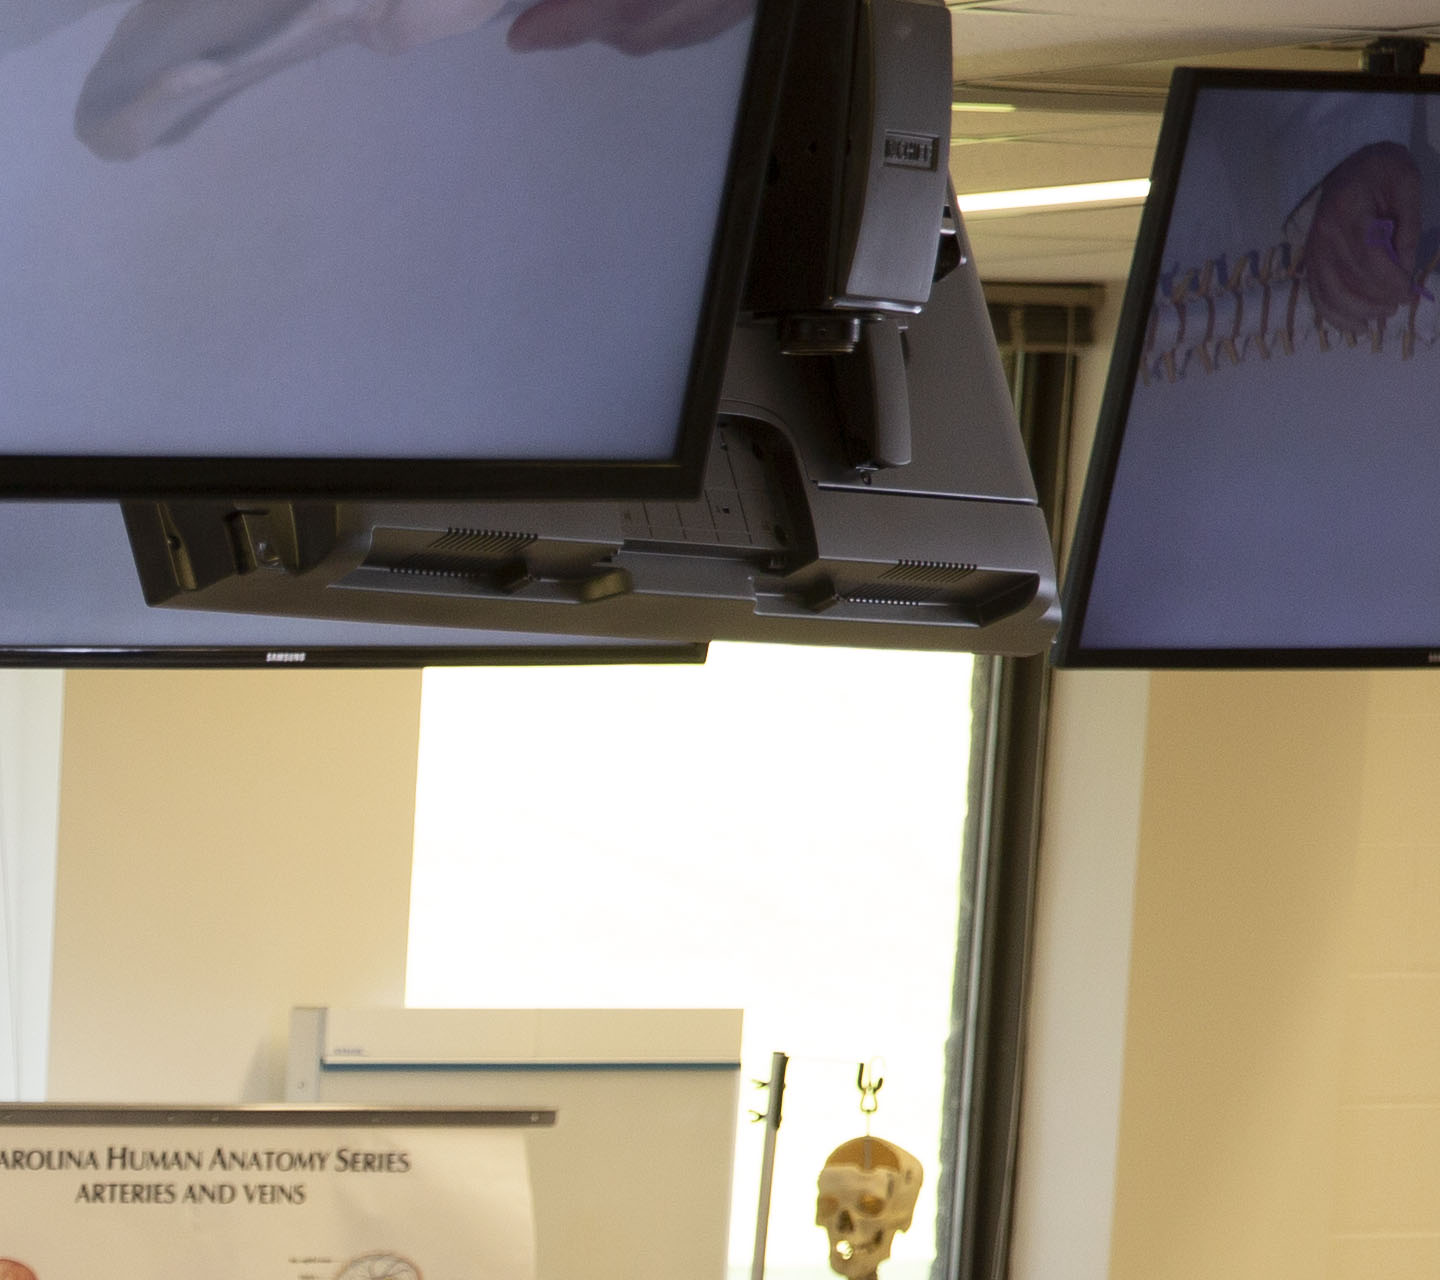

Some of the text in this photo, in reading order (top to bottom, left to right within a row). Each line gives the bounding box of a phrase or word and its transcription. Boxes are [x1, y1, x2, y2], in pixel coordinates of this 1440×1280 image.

[106, 1146, 202, 1172] HUMAN
[208, 1147, 330, 1173] ANATOMY
[334, 1148, 412, 1174] SERIES
[74, 1182, 307, 1206] ARTERIES AND VEINS
